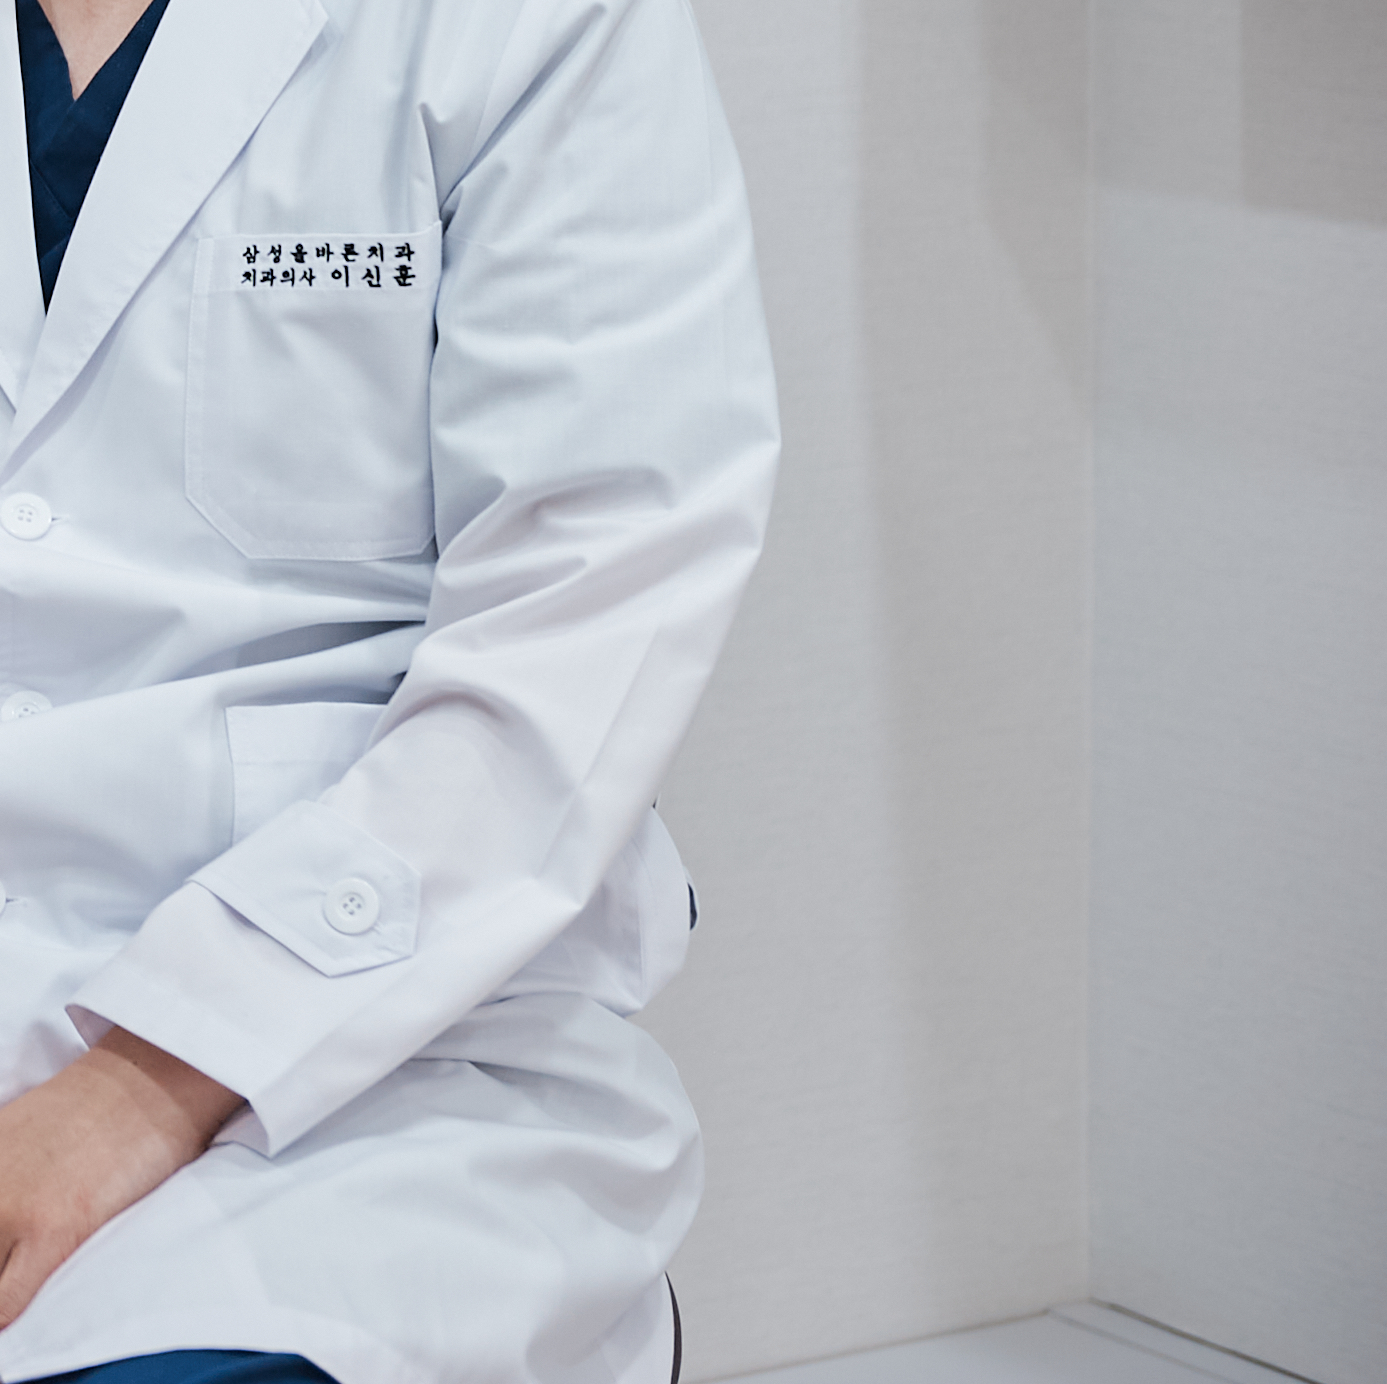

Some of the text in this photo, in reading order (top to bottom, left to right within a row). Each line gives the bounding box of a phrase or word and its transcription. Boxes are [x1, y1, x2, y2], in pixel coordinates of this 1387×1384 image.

[241, 242, 415, 265] 삼성올바른치과
[241, 265, 417, 288] 치과의사 이신훈
